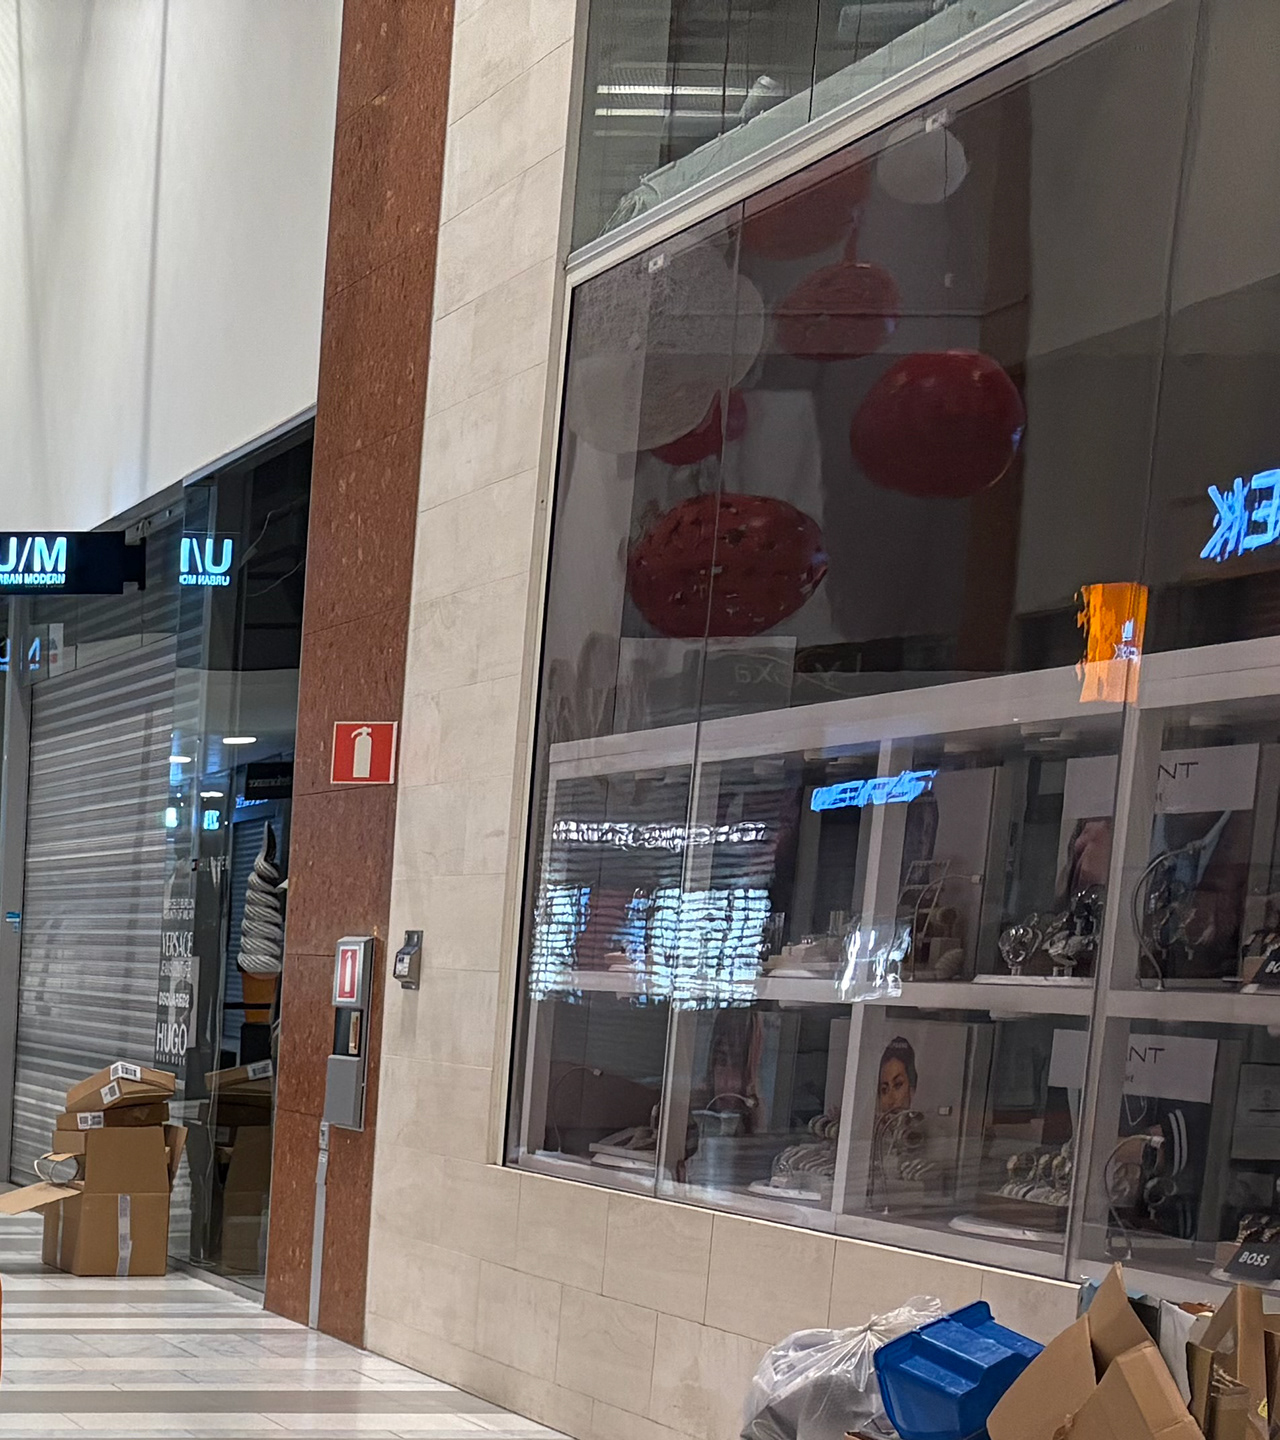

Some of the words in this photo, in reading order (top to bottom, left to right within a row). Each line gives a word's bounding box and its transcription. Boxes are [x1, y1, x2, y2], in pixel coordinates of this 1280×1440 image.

[24, 573, 66, 585] MODERN
[156, 1022, 187, 1056] HUGO
[1238, 1251, 1270, 1267] BOSS
